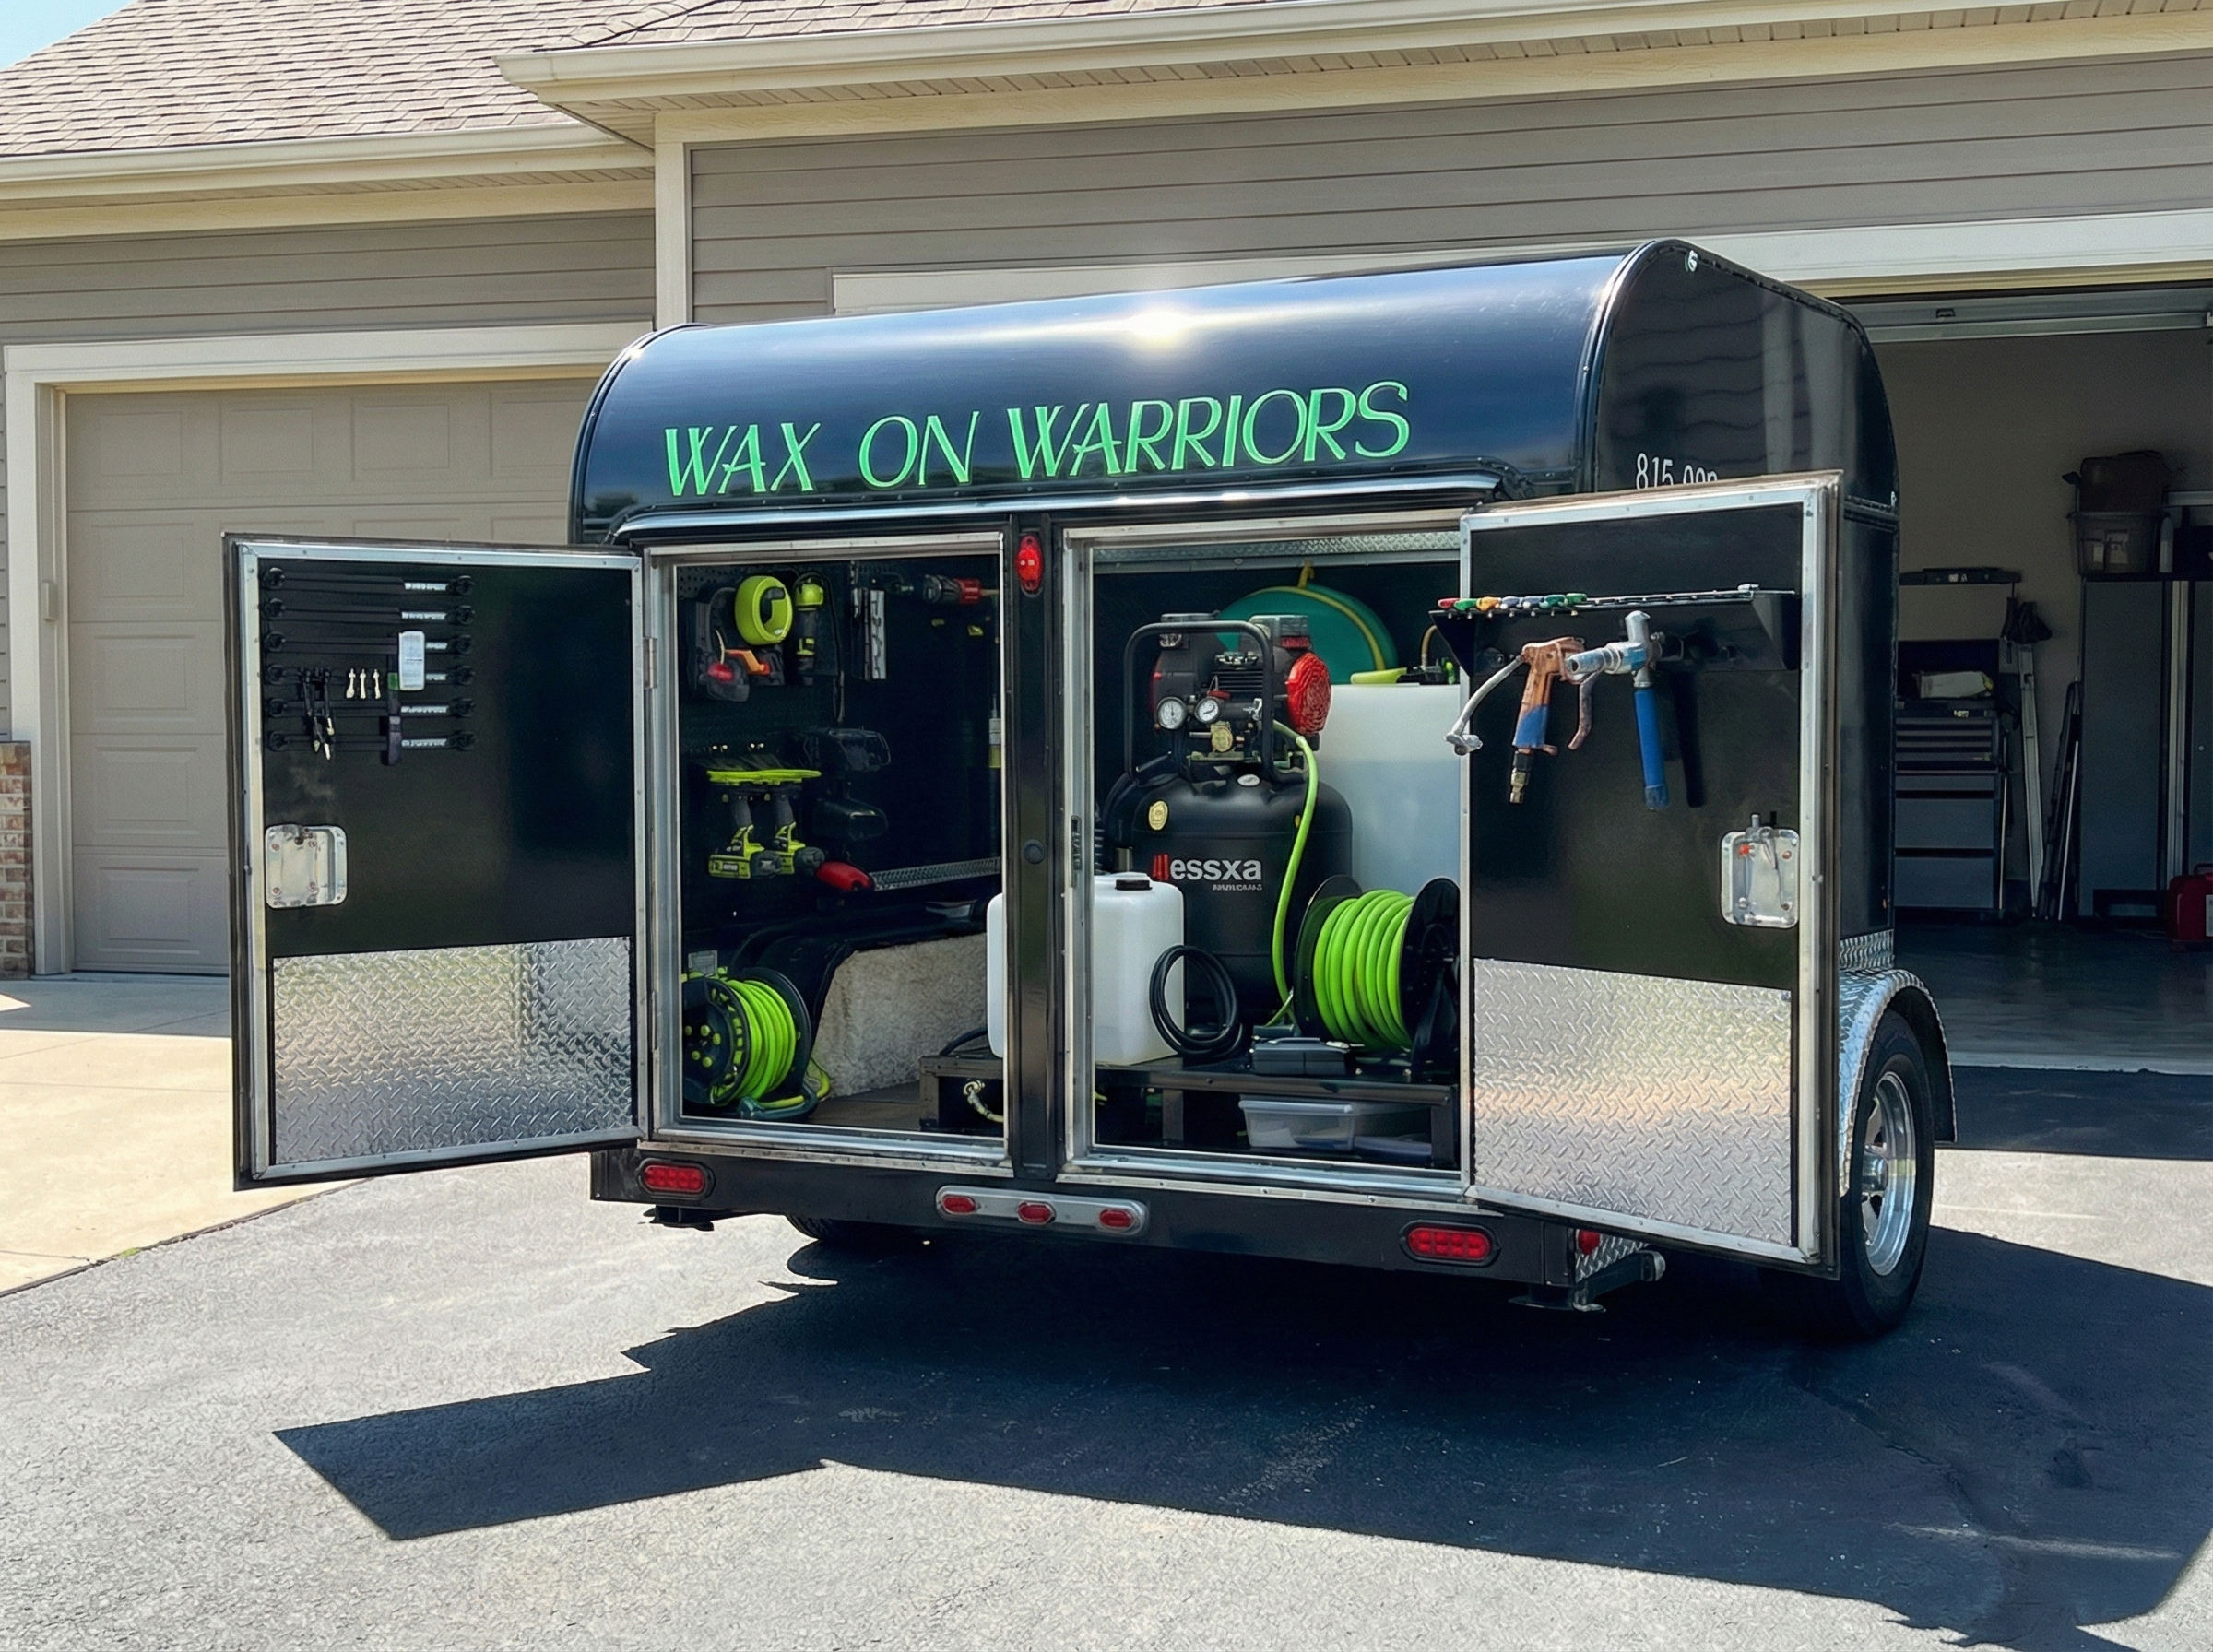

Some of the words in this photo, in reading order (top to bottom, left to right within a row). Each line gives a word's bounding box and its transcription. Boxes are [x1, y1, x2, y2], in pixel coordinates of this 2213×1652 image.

[664, 422, 822, 496] WAX
[858, 411, 980, 488] ON
[1006, 381, 1411, 479] WARRIORS
